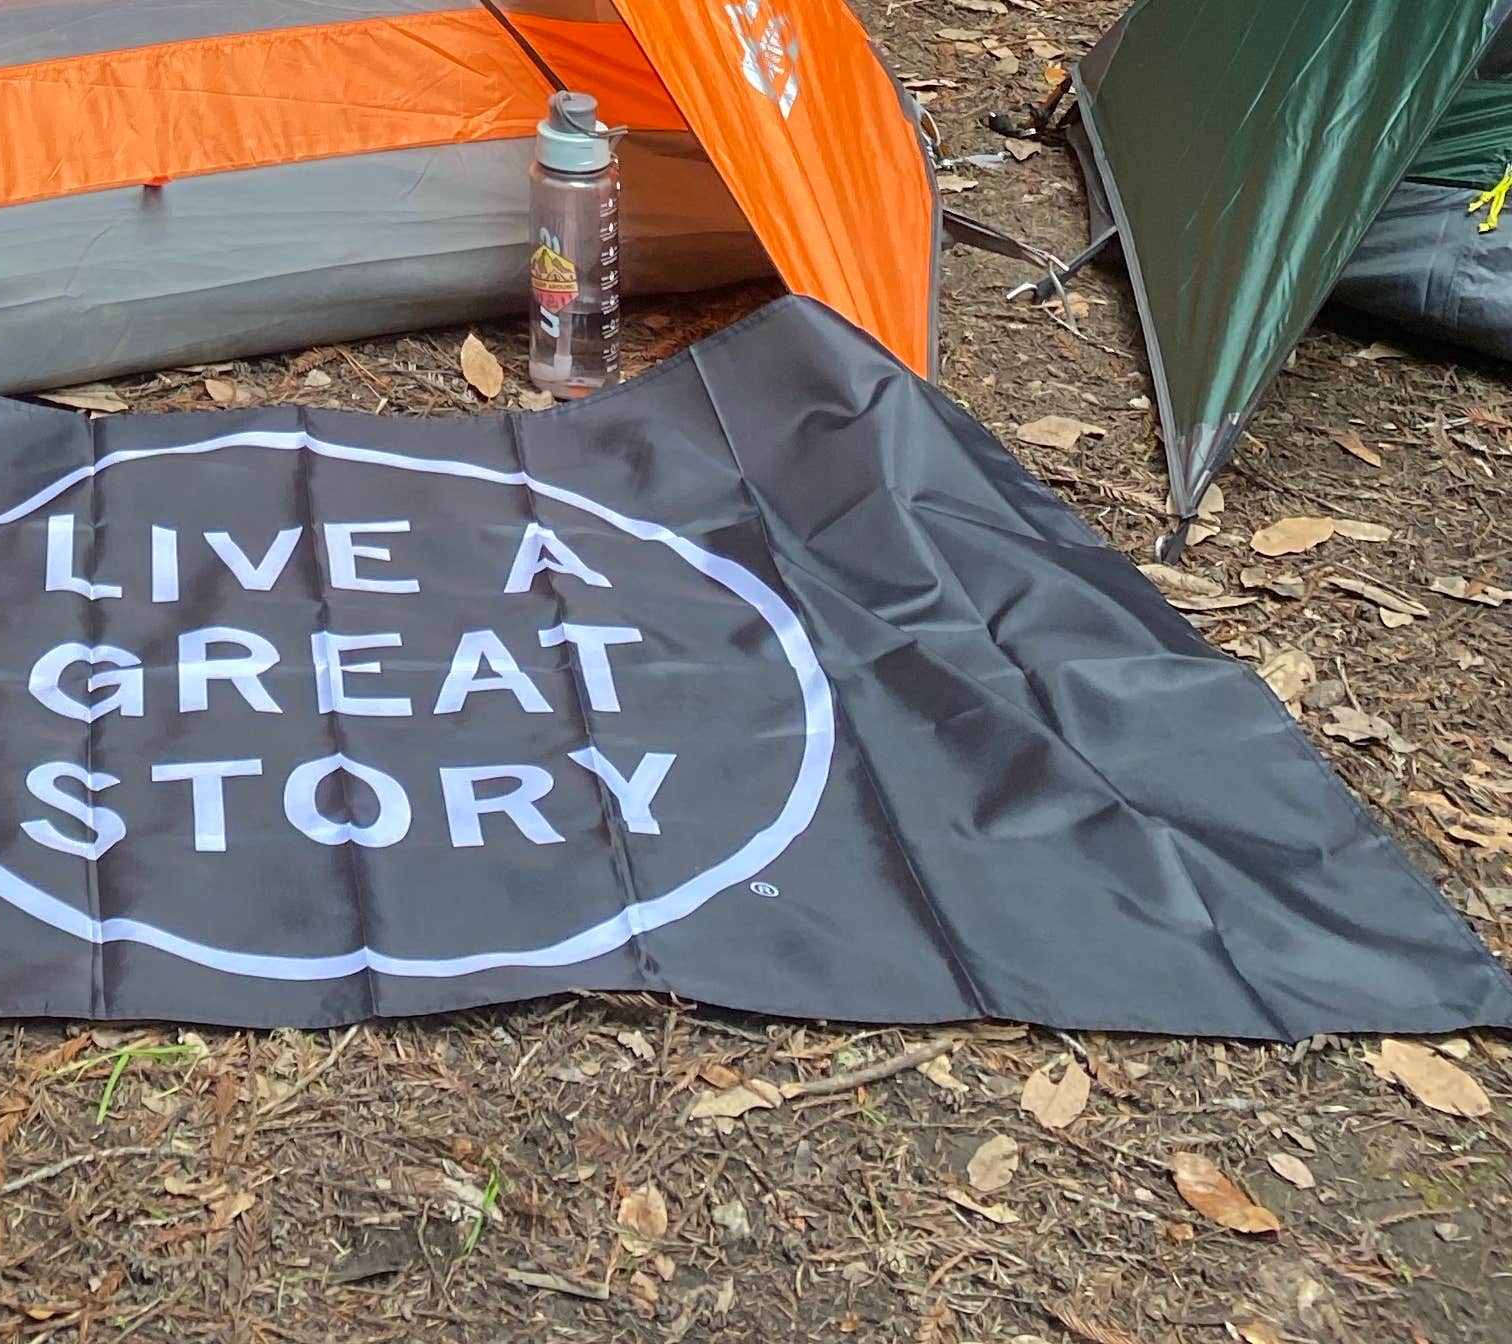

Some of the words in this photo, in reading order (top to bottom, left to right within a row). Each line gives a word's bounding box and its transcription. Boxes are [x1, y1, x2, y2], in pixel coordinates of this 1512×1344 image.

[44, 513, 421, 603] LIVE
[503, 521, 613, 595] A
[27, 622, 644, 724] GREAT
[20, 746, 678, 861] STORY
